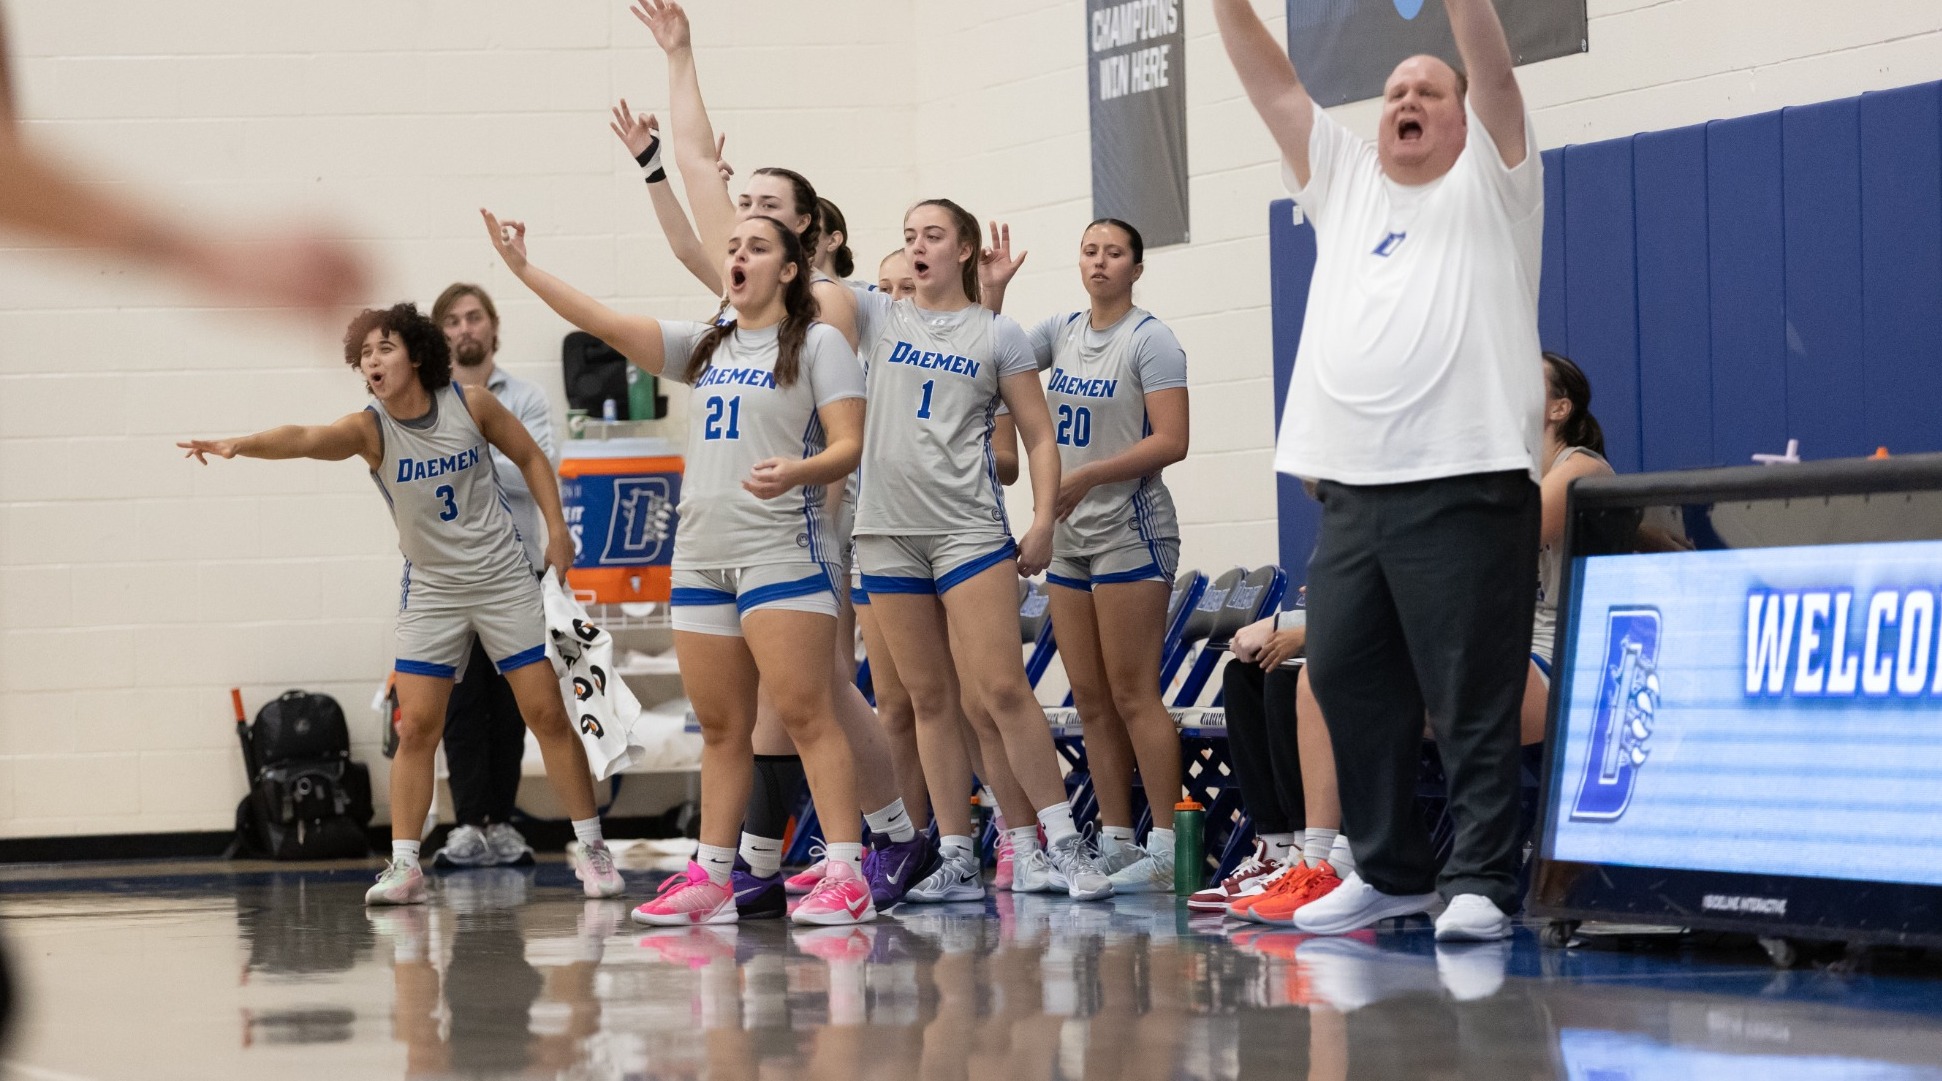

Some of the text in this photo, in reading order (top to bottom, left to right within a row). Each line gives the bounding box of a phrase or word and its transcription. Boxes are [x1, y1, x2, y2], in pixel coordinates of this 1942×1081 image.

[1092, 0, 1178, 52] CHAMPIONS
[1100, 44, 1171, 100] WIN HERE
[694, 364, 778, 390] DAEMEN
[887, 340, 981, 379] DAEMEN
[916, 379, 935, 420] 1
[1047, 367, 1119, 398] DAEMEN
[704, 394, 742, 441] 21
[1056, 403, 1092, 449] 20
[396, 445, 480, 484] DAEMEN
[435, 483, 459, 523] 3
[1745, 588, 1942, 693] WELCO
